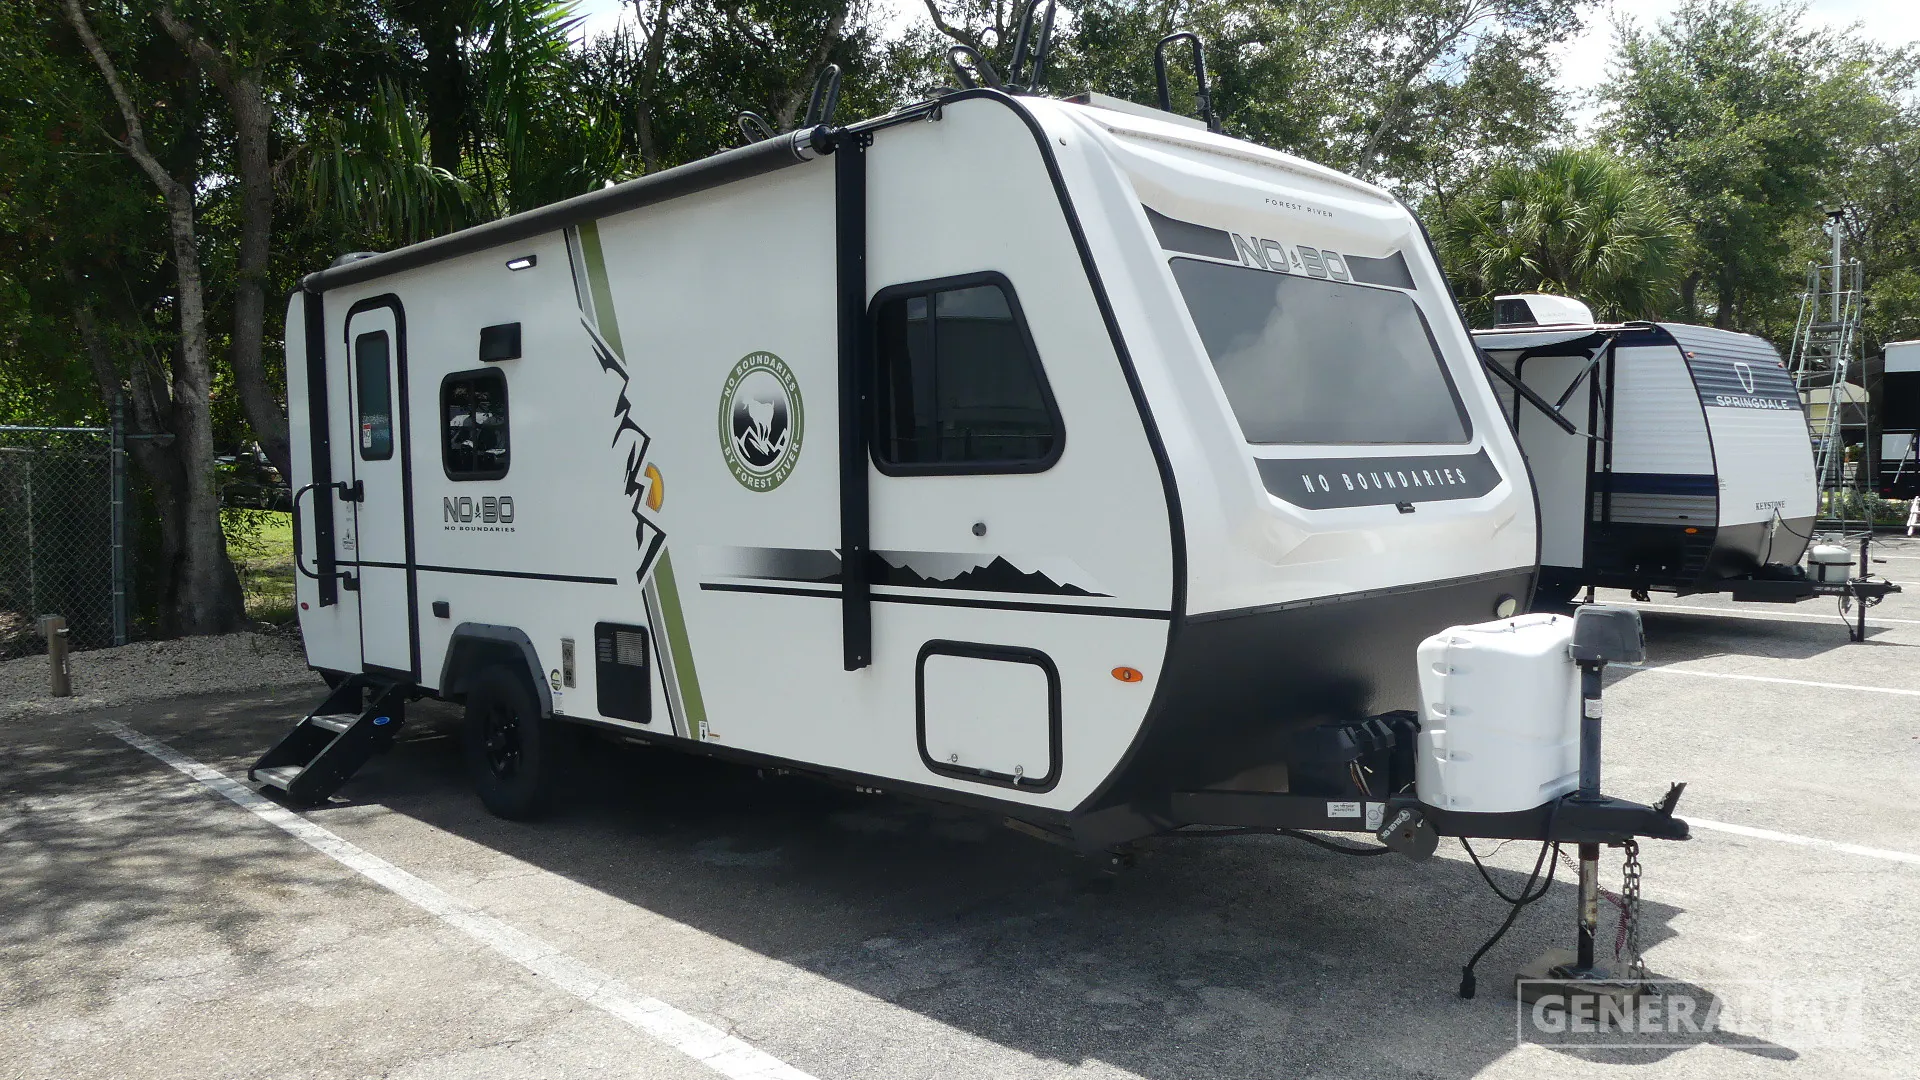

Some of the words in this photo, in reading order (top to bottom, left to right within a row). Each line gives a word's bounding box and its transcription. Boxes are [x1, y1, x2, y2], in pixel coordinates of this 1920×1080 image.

[1265, 198, 1302, 212] FOREST
[1307, 206, 1333, 218] RIVER
[724, 378, 735, 397] NO
[736, 354, 796, 392] BOUNDARIES
[1716, 395, 1790, 410] SPRINGDALE
[724, 446, 736, 464] BY
[735, 468, 772, 488] FOREST
[775, 442, 799, 482] RIVER
[1302, 474, 1330, 493] NO
[1341, 468, 1466, 491] BOUNDARIES
[1755, 501, 1786, 510] KEYSTONE
